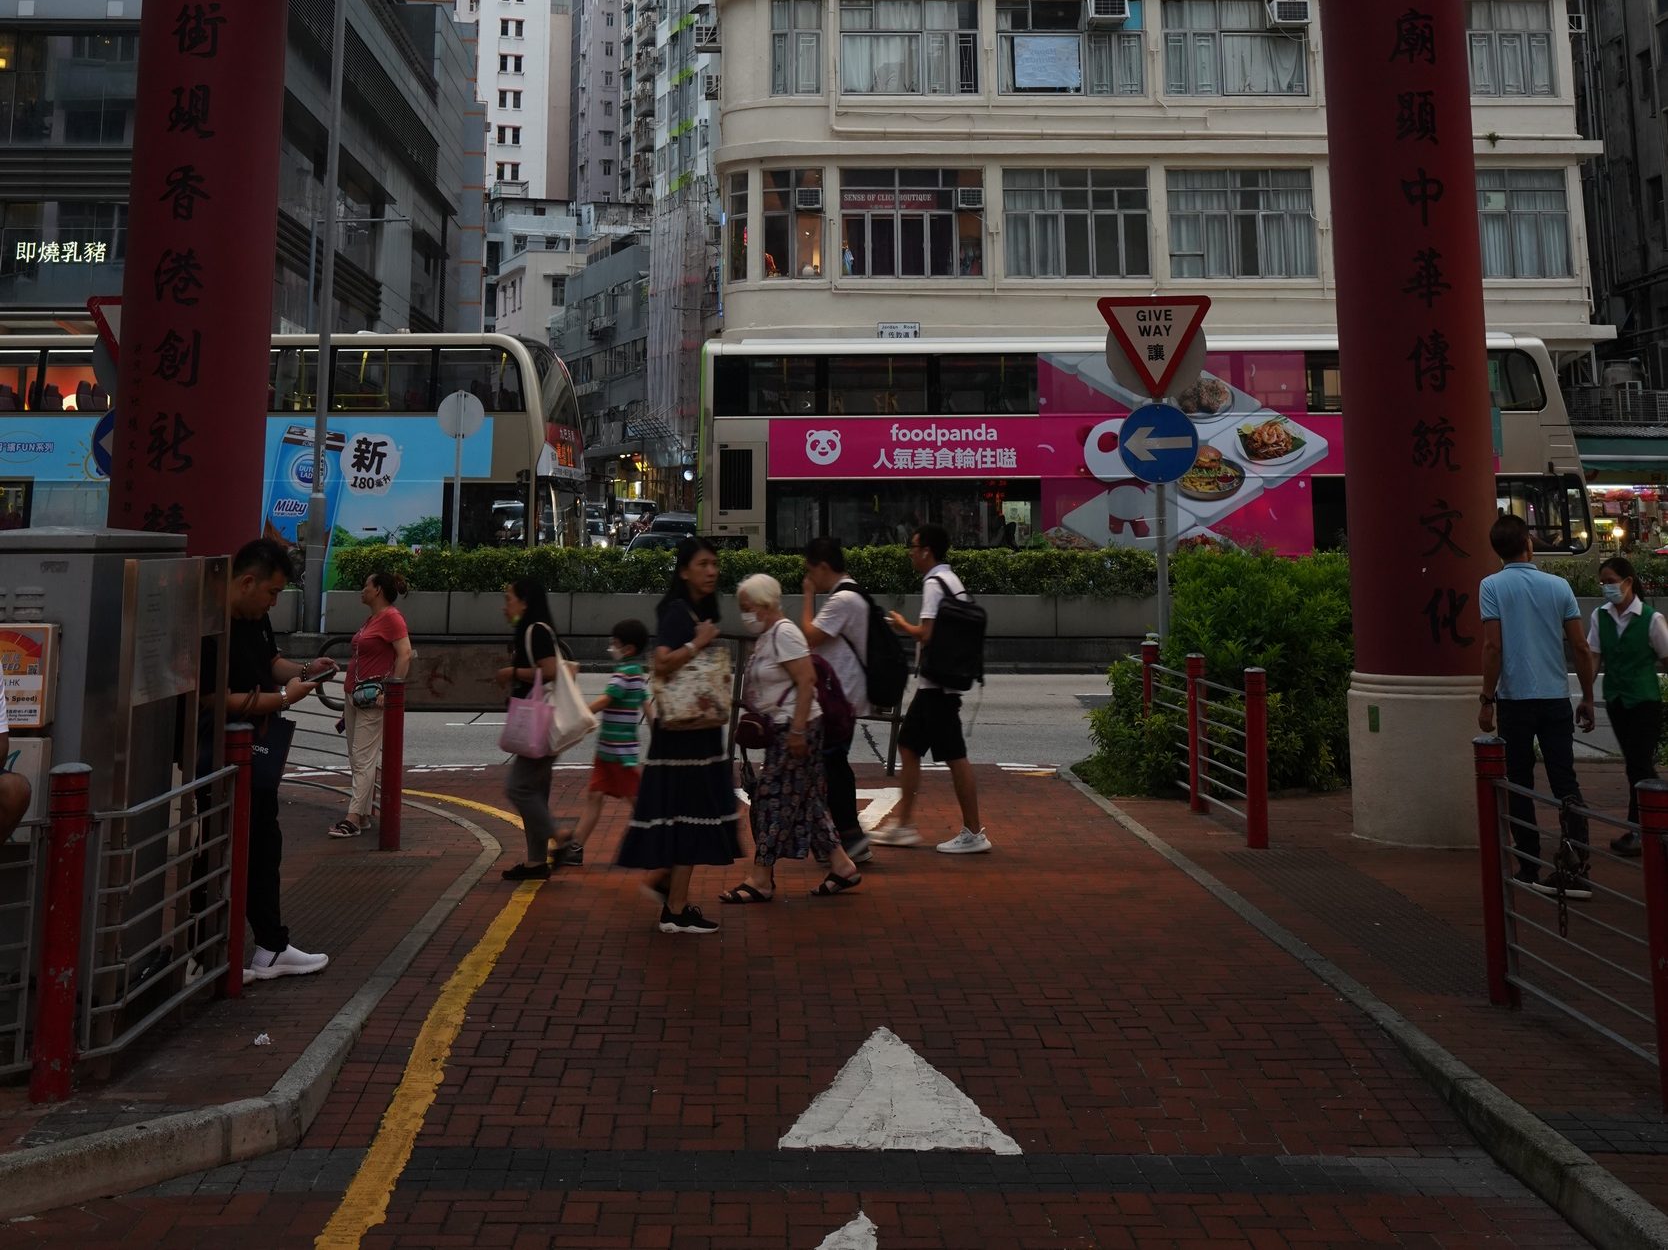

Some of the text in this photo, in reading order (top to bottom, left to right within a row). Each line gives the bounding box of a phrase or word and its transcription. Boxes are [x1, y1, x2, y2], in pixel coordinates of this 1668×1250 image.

[843, 193, 866, 201] SENSE
[866, 193, 876, 201] OF
[899, 193, 932, 202] BOUTIQUE
[15, 241, 107, 263] 即燒乳豬
[1136, 309, 1173, 321] GIVE
[1138, 324, 1172, 337] WAY
[1147, 344, 1165, 361] 讓
[889, 423, 998, 446] foodpanda
[351, 436, 388, 475] 新
[873, 448, 1017, 469] 人氣美食輪住嗌
[300, 471, 313, 479] LAD
[274, 500, 307, 515] Milky
